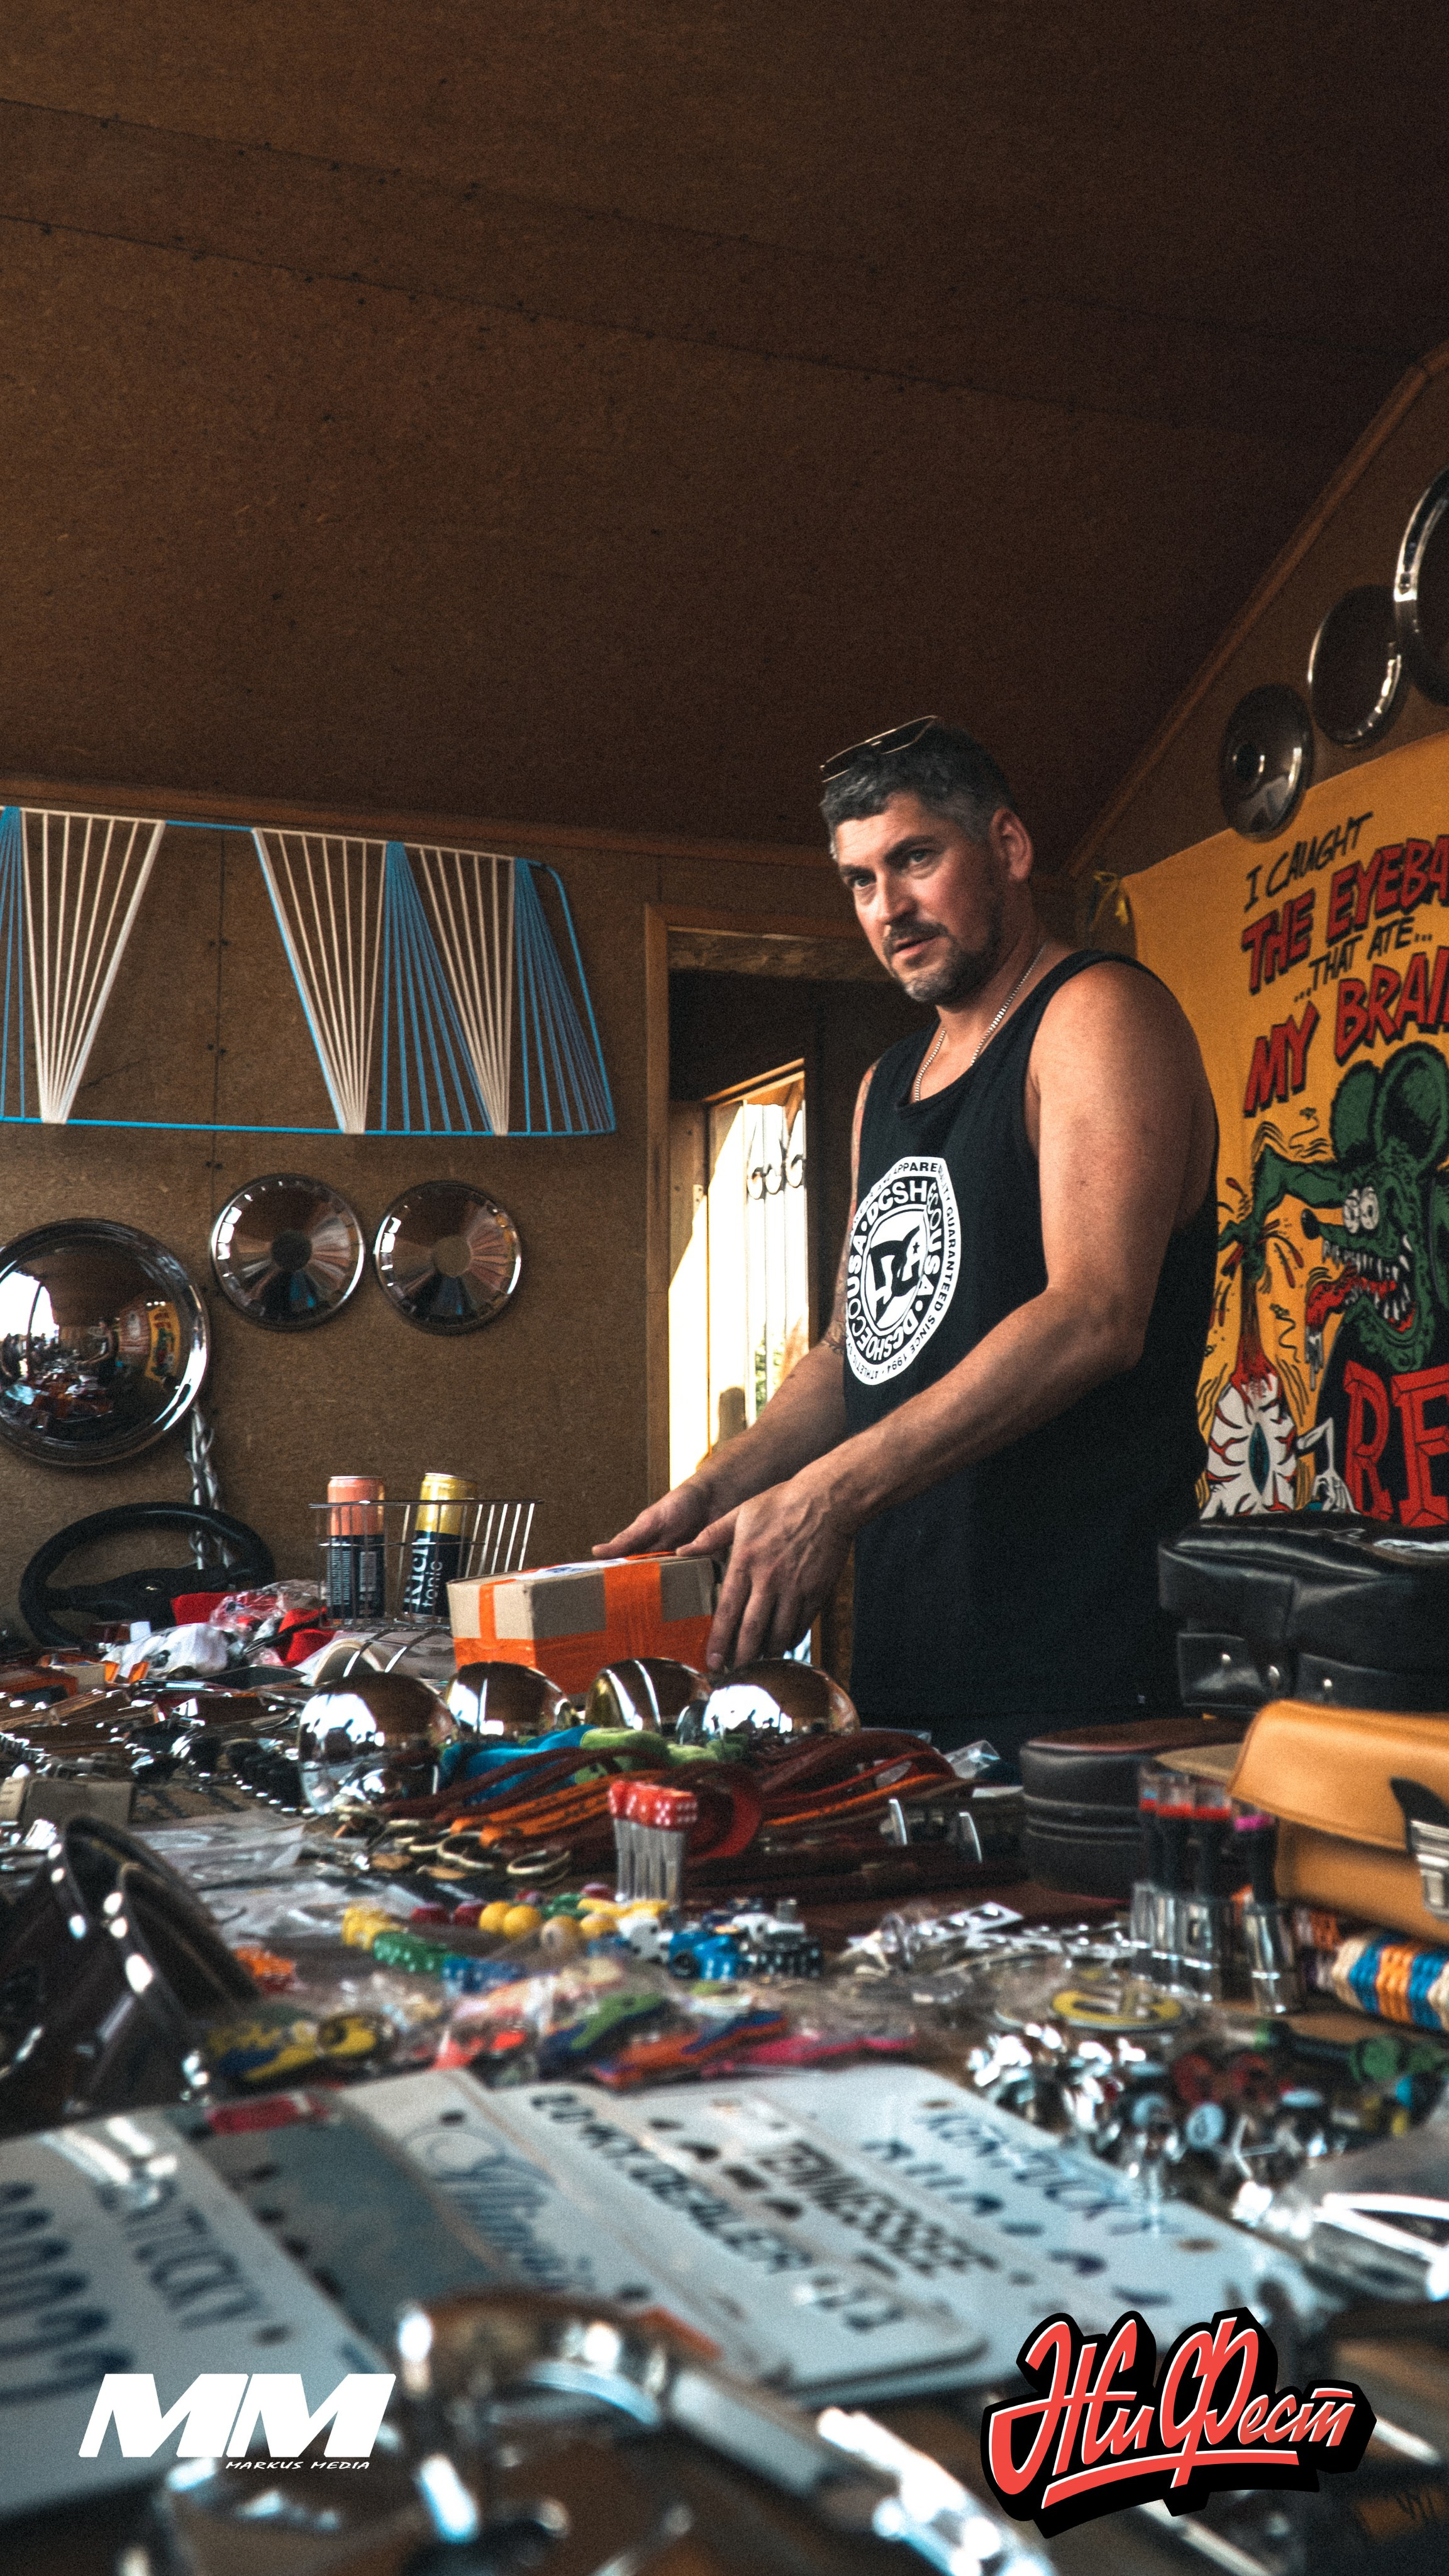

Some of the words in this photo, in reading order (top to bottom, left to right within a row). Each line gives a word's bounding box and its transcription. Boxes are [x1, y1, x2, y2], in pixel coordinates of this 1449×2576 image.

[1243, 865, 1262, 912] I
[1265, 811, 1374, 899] CAUGHT
[1241, 889, 1316, 995] THE
[1243, 1001, 1319, 1118] MY
[1335, 946, 1449, 1066] BRAI
[894, 1162, 938, 1174] APPARE
[933, 1206, 957, 1312] GUARANTEED
[887, 1353, 908, 1374] 1994
[910, 1315, 936, 1354] SINCE
[421, 1560, 443, 1608] tonic
